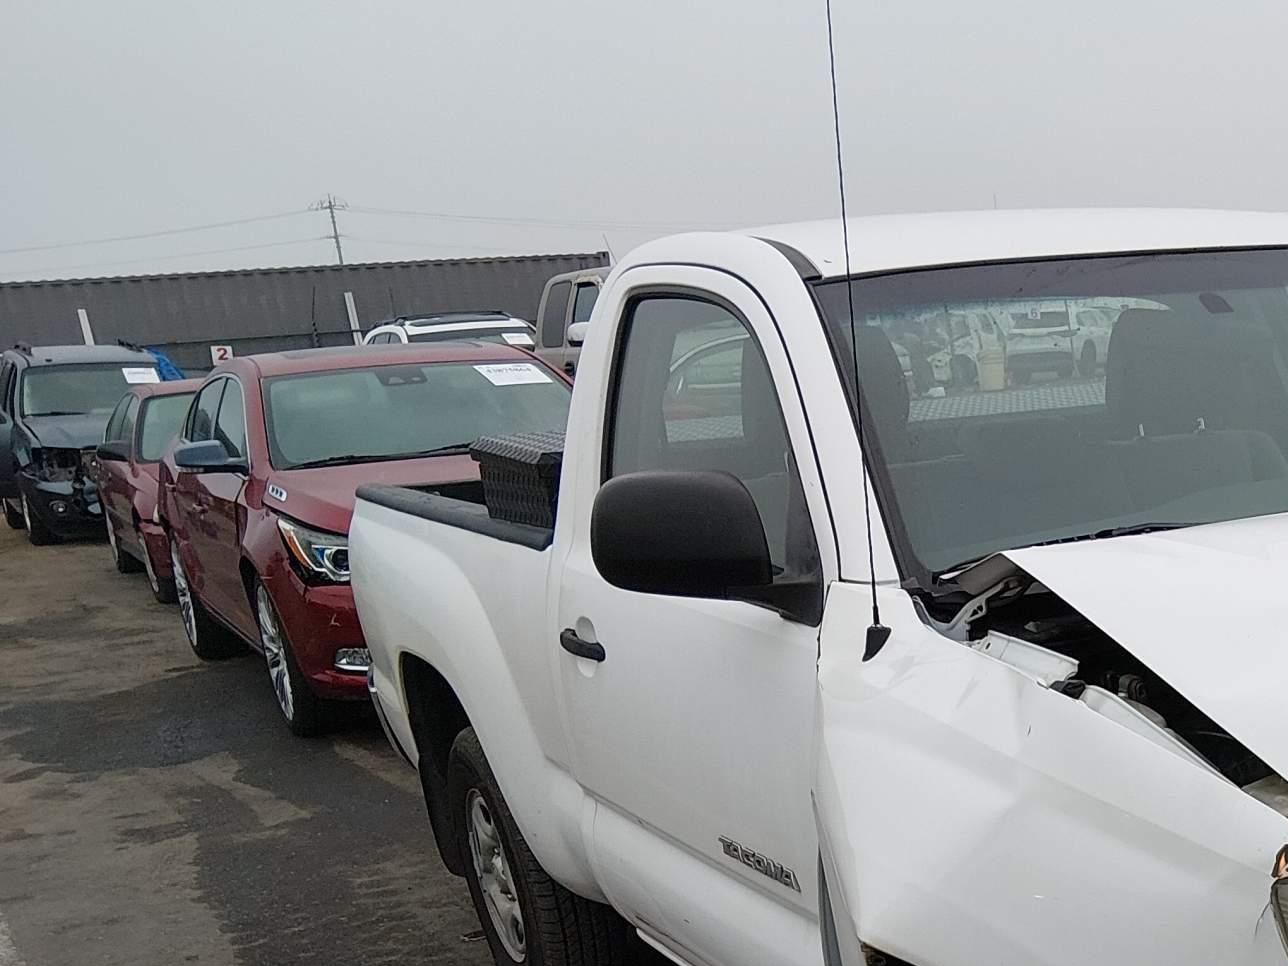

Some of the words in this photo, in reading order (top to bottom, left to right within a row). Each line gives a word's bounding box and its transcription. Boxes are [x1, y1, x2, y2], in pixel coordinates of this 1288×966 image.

[1031, 308, 1038, 319] 6
[216, 348, 229, 361] 2
[718, 835, 801, 893] TACOMA
